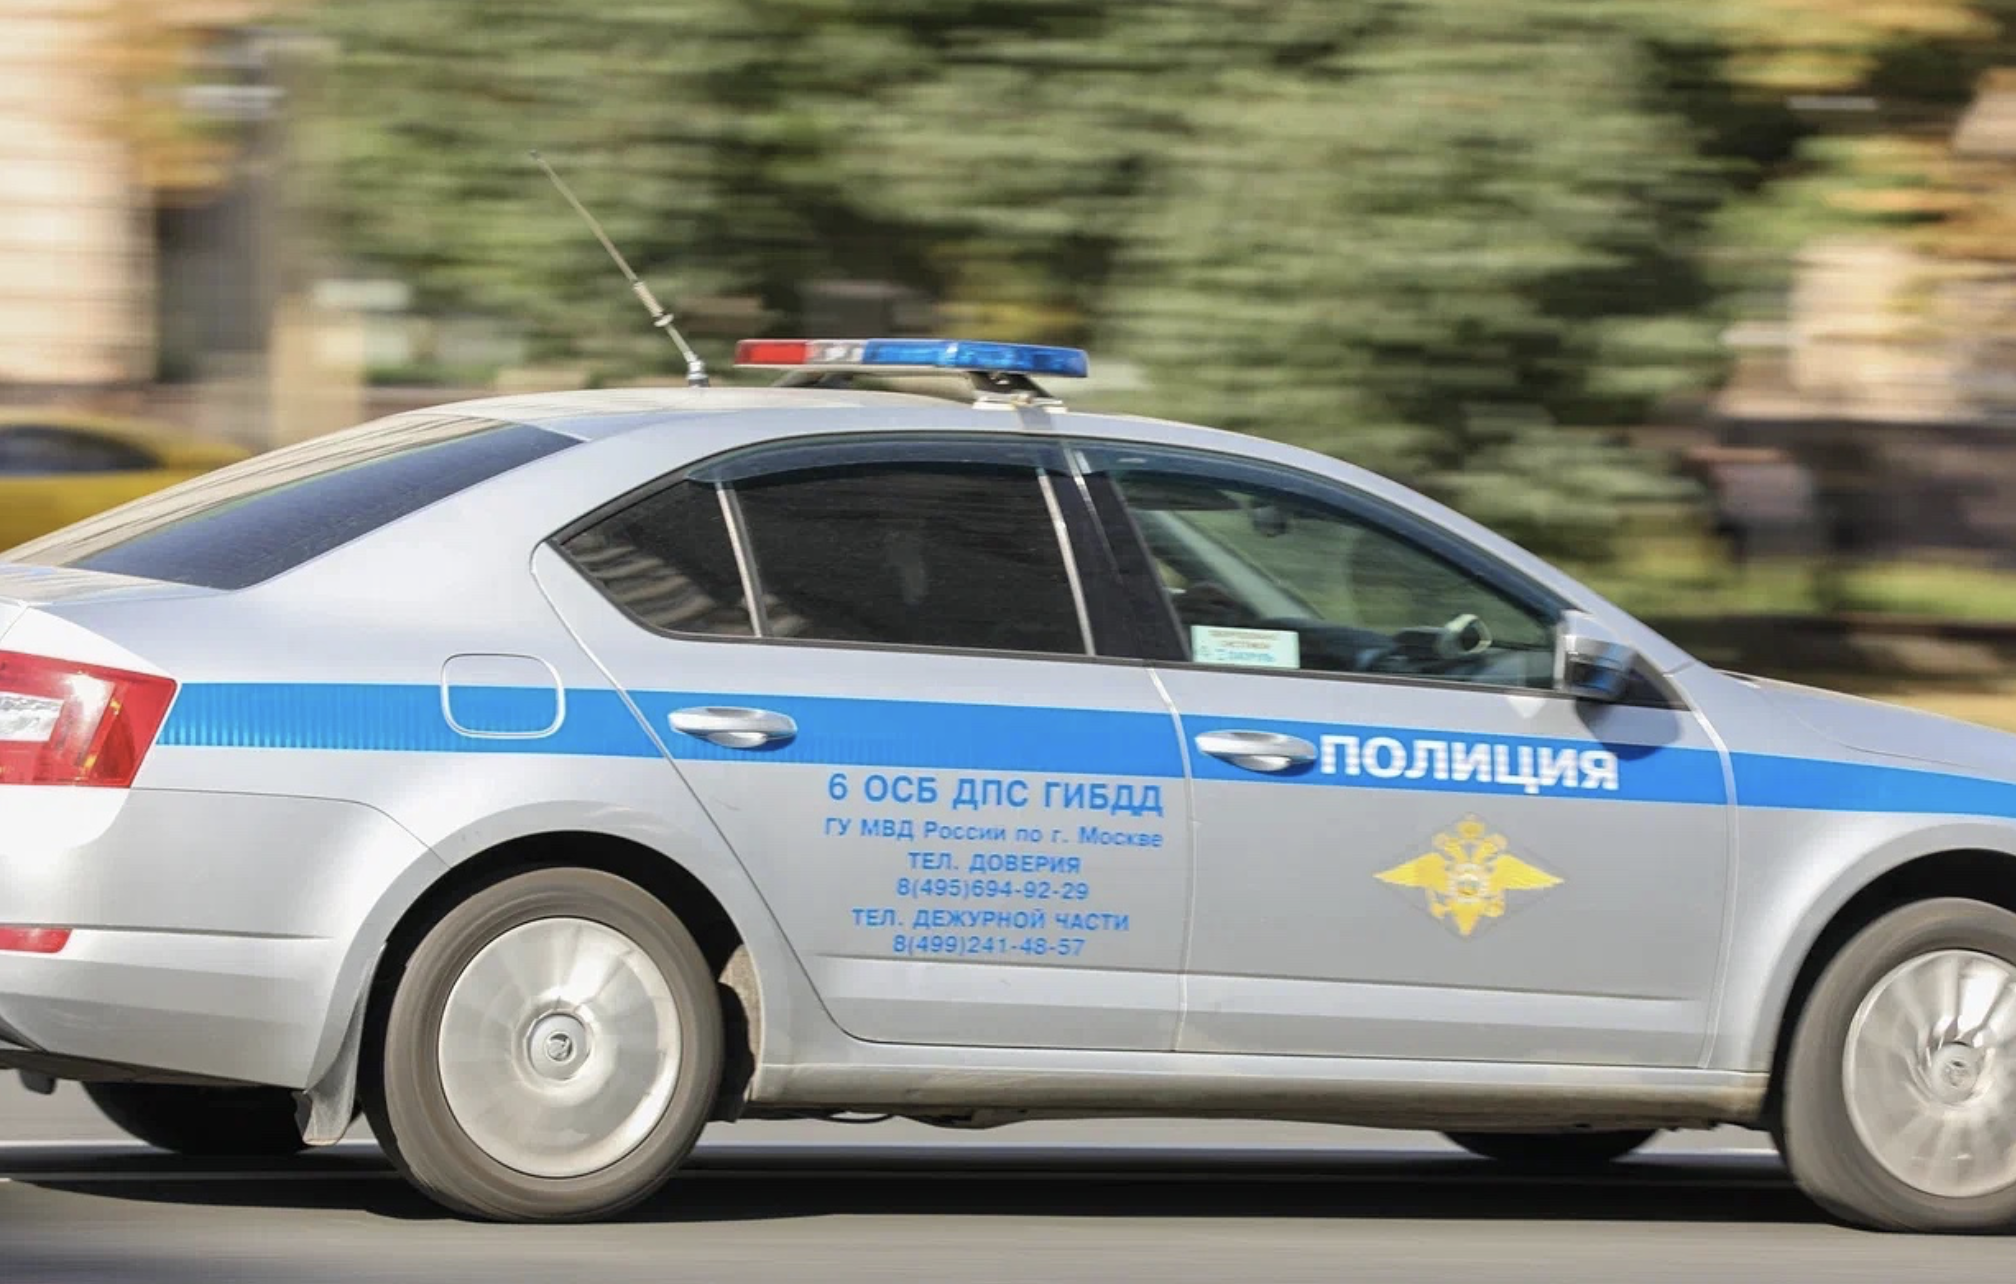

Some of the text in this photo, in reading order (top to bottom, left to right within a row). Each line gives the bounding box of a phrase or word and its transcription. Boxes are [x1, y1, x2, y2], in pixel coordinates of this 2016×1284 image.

[1319, 734, 1620, 794] ПОЛИЦИЯ
[827, 773, 1164, 818] 6 ОСБ ДПС ГИБДД
[824, 816, 1164, 848] ГУ МВД России по г. Москве
[908, 850, 1082, 874] ТЕЛ. ДОВЕРИЯ
[896, 877, 1090, 901] 8(495)694-92-29
[851, 907, 1130, 932] ТЕЛ. ДЕЖУРНОЙ ЧАСТИ
[892, 933, 1087, 957] 8(499)241-48-57
